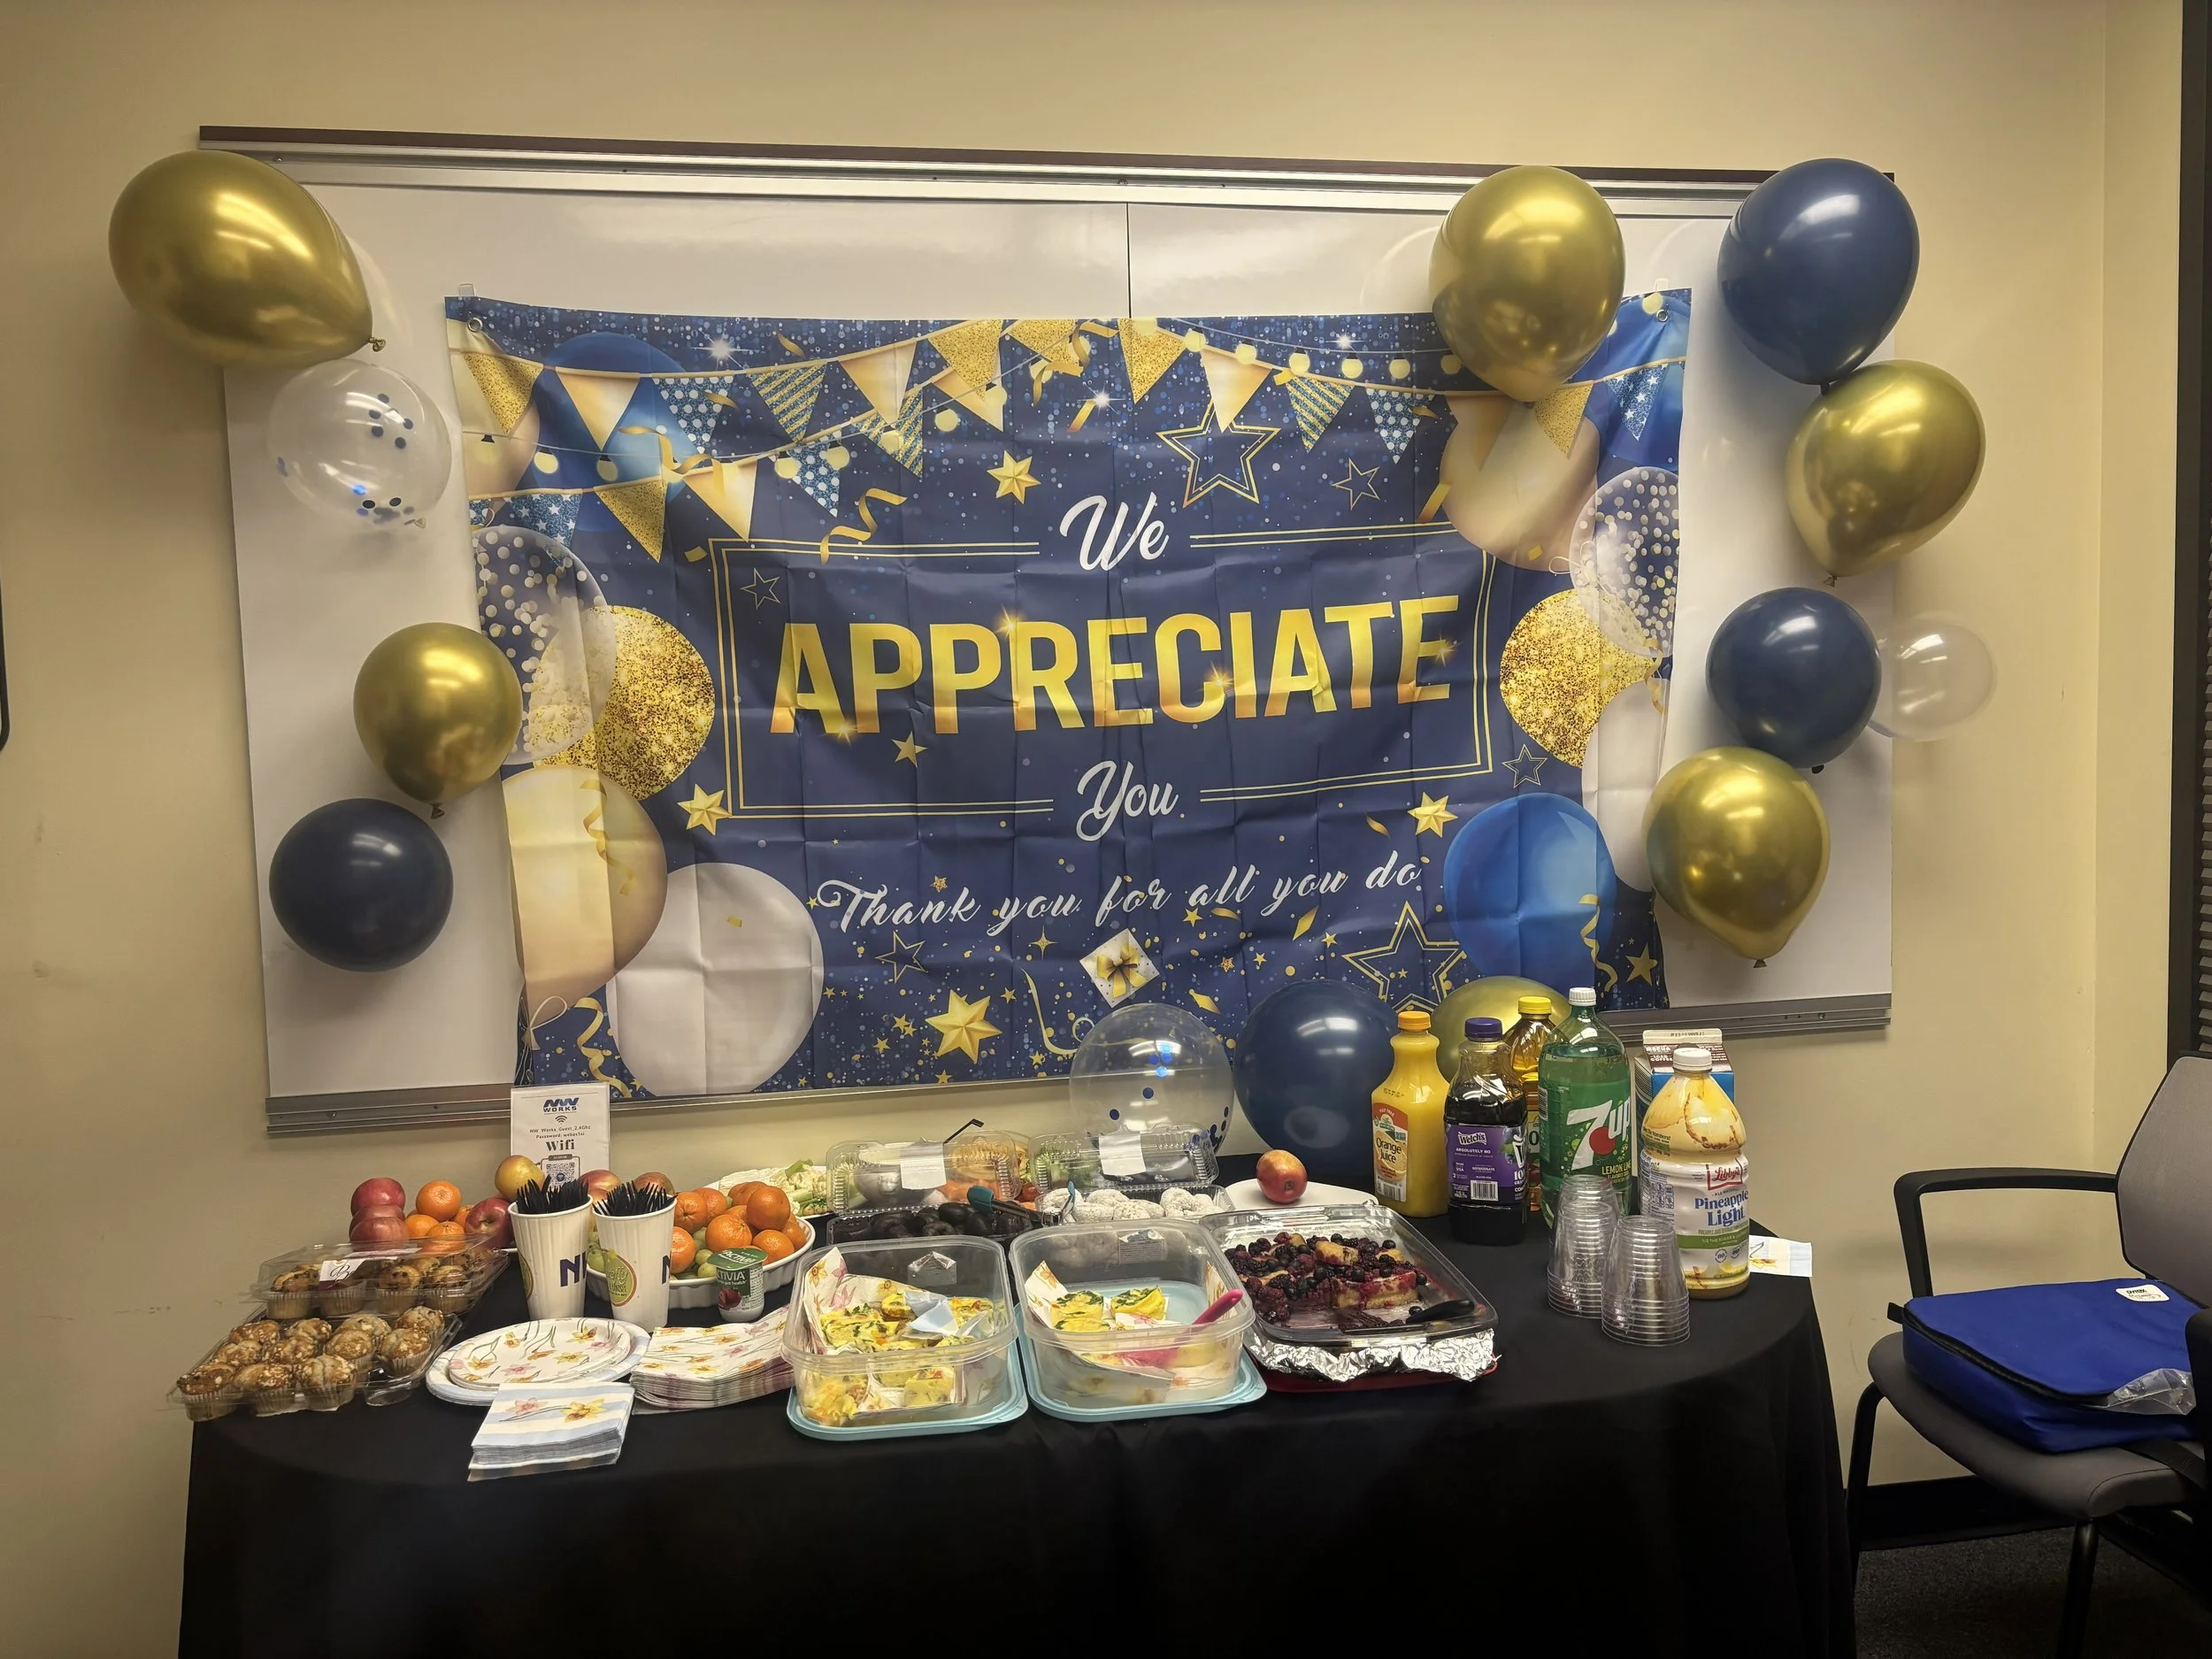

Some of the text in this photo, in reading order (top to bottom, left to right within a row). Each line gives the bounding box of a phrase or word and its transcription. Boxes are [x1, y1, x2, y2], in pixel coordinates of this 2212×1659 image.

[1059, 491, 1170, 572] We
[770, 595, 1460, 735] APPRECIATE
[1076, 760, 1179, 841] You
[817, 849, 1423, 936] Thank you for all you do
[543, 1097, 580, 1108] NW
[546, 1139, 575, 1151] Wifi
[1376, 1137, 1402, 1155] Orange
[1458, 1133, 1486, 1144] Welch's
[1380, 1148, 1396, 1164] Juice
[1602, 1164, 1623, 1175] LEMON
[1712, 1167, 1740, 1181] Libby's
[1694, 1190, 1748, 1209] Pineapple
[1708, 1205, 1746, 1226] Light
